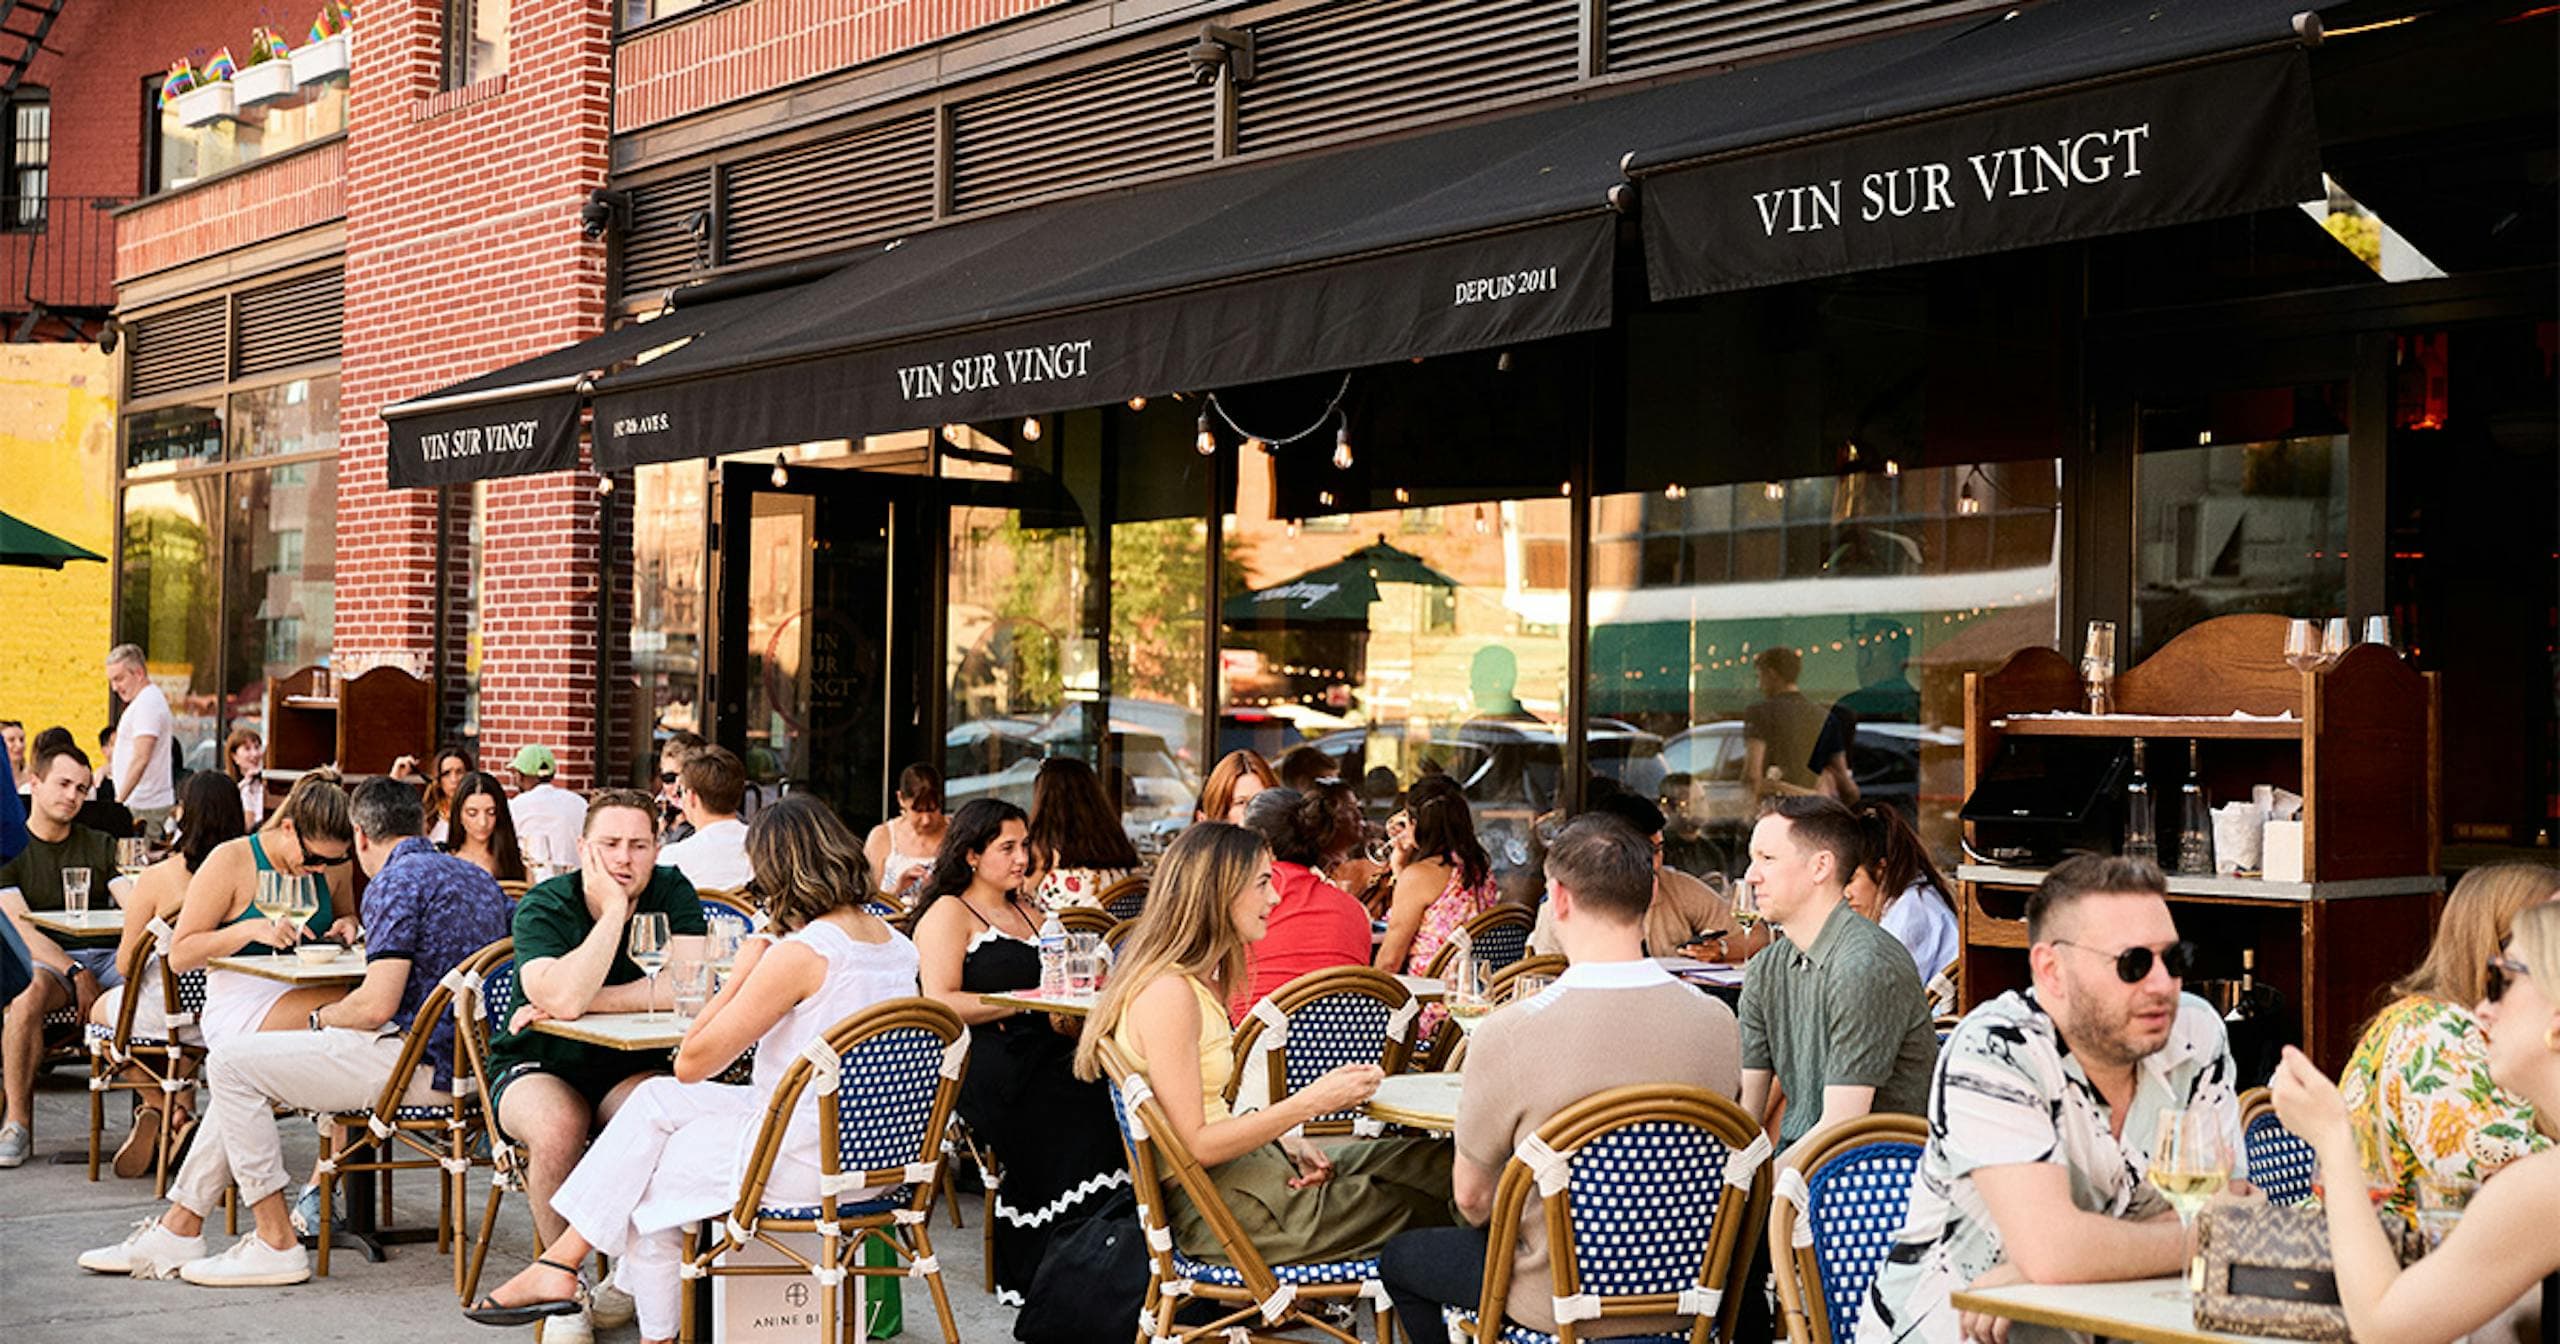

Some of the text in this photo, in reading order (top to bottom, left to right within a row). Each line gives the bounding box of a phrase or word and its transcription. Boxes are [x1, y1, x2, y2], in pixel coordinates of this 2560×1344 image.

[1753, 122, 2150, 237] VIN SUR VINGT
[1453, 266, 1557, 306] DEPUIS 2011
[897, 339, 1092, 400] VIN SUR VINGT
[421, 419, 539, 461] VIN SUR VINGT
[754, 1313, 800, 1328] ANINE
